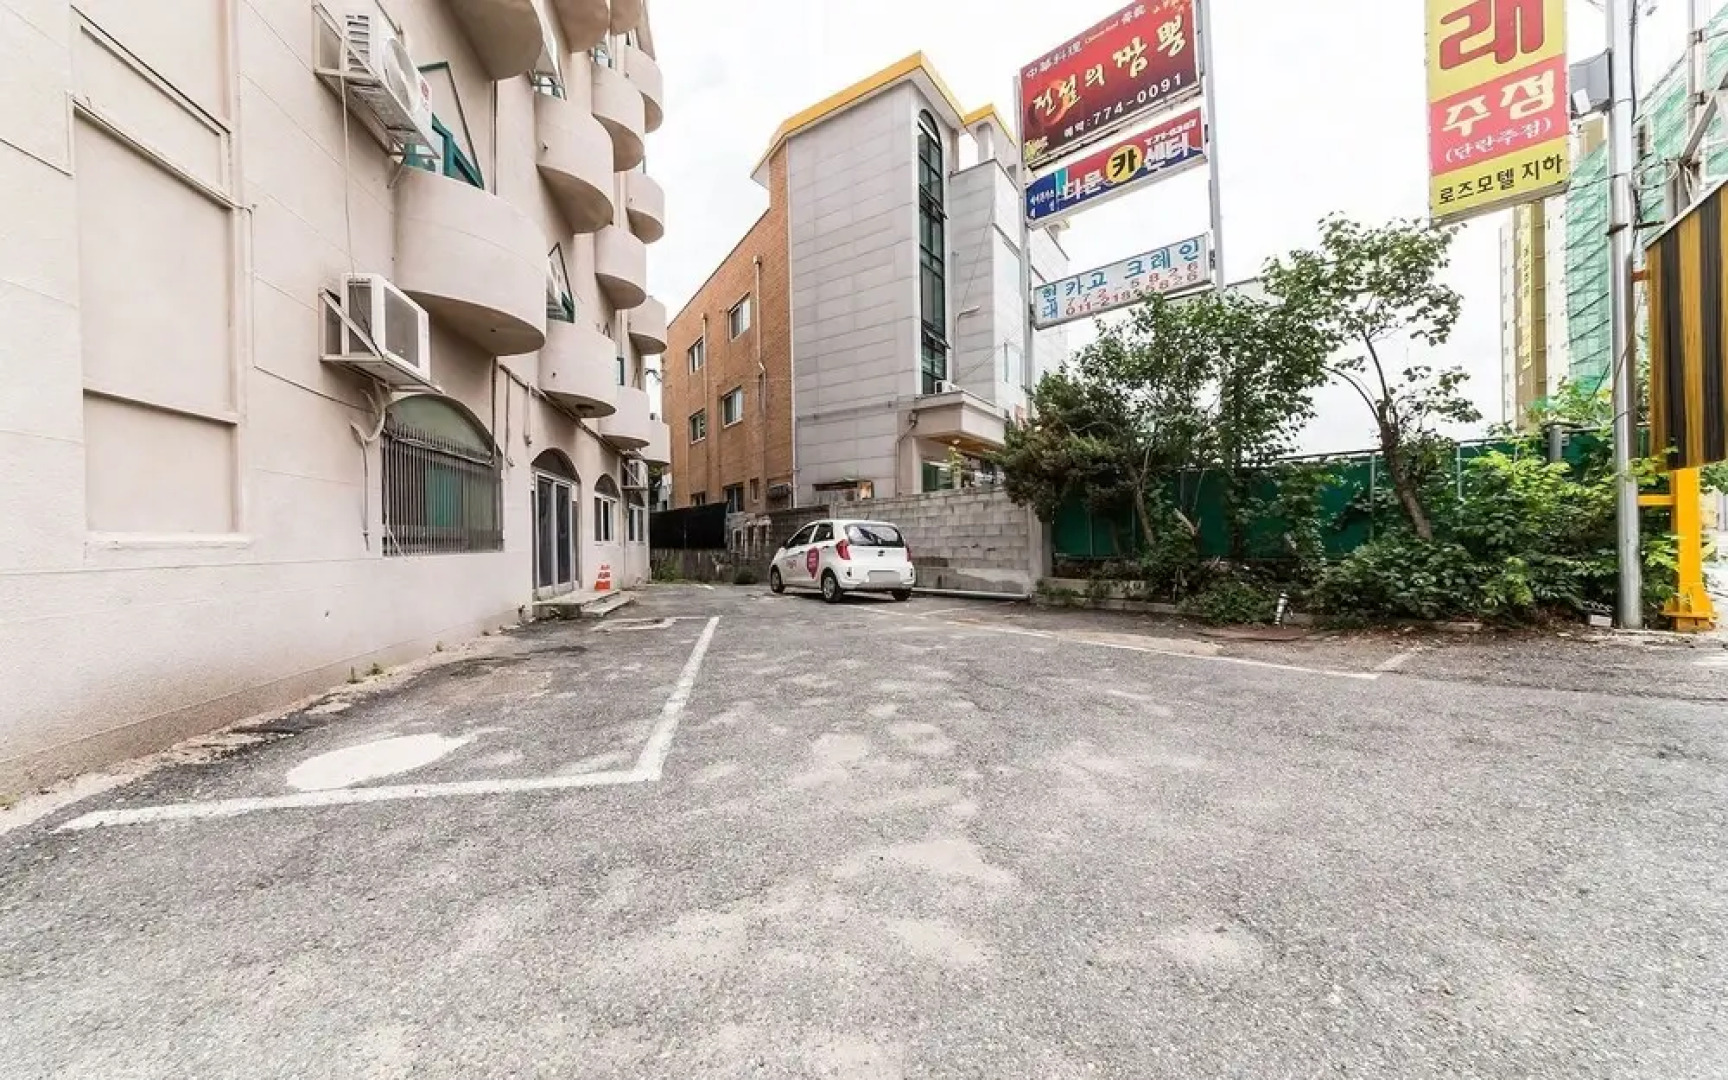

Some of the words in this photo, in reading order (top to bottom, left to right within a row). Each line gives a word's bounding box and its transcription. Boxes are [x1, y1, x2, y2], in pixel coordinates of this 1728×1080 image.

[1032, 63, 1106, 117] 전설의
[1112, 15, 1187, 79] 짬뽕
[1439, 0, 1545, 70] 래
[1443, 68, 1555, 138] 주점
[1445, 117, 1552, 163] (단란주점)
[1438, 167, 1515, 205] 로즈모텔
[1521, 153, 1564, 181] 지하
[1065, 271, 1107, 297] 카고
[1124, 238, 1200, 279] 크레인
